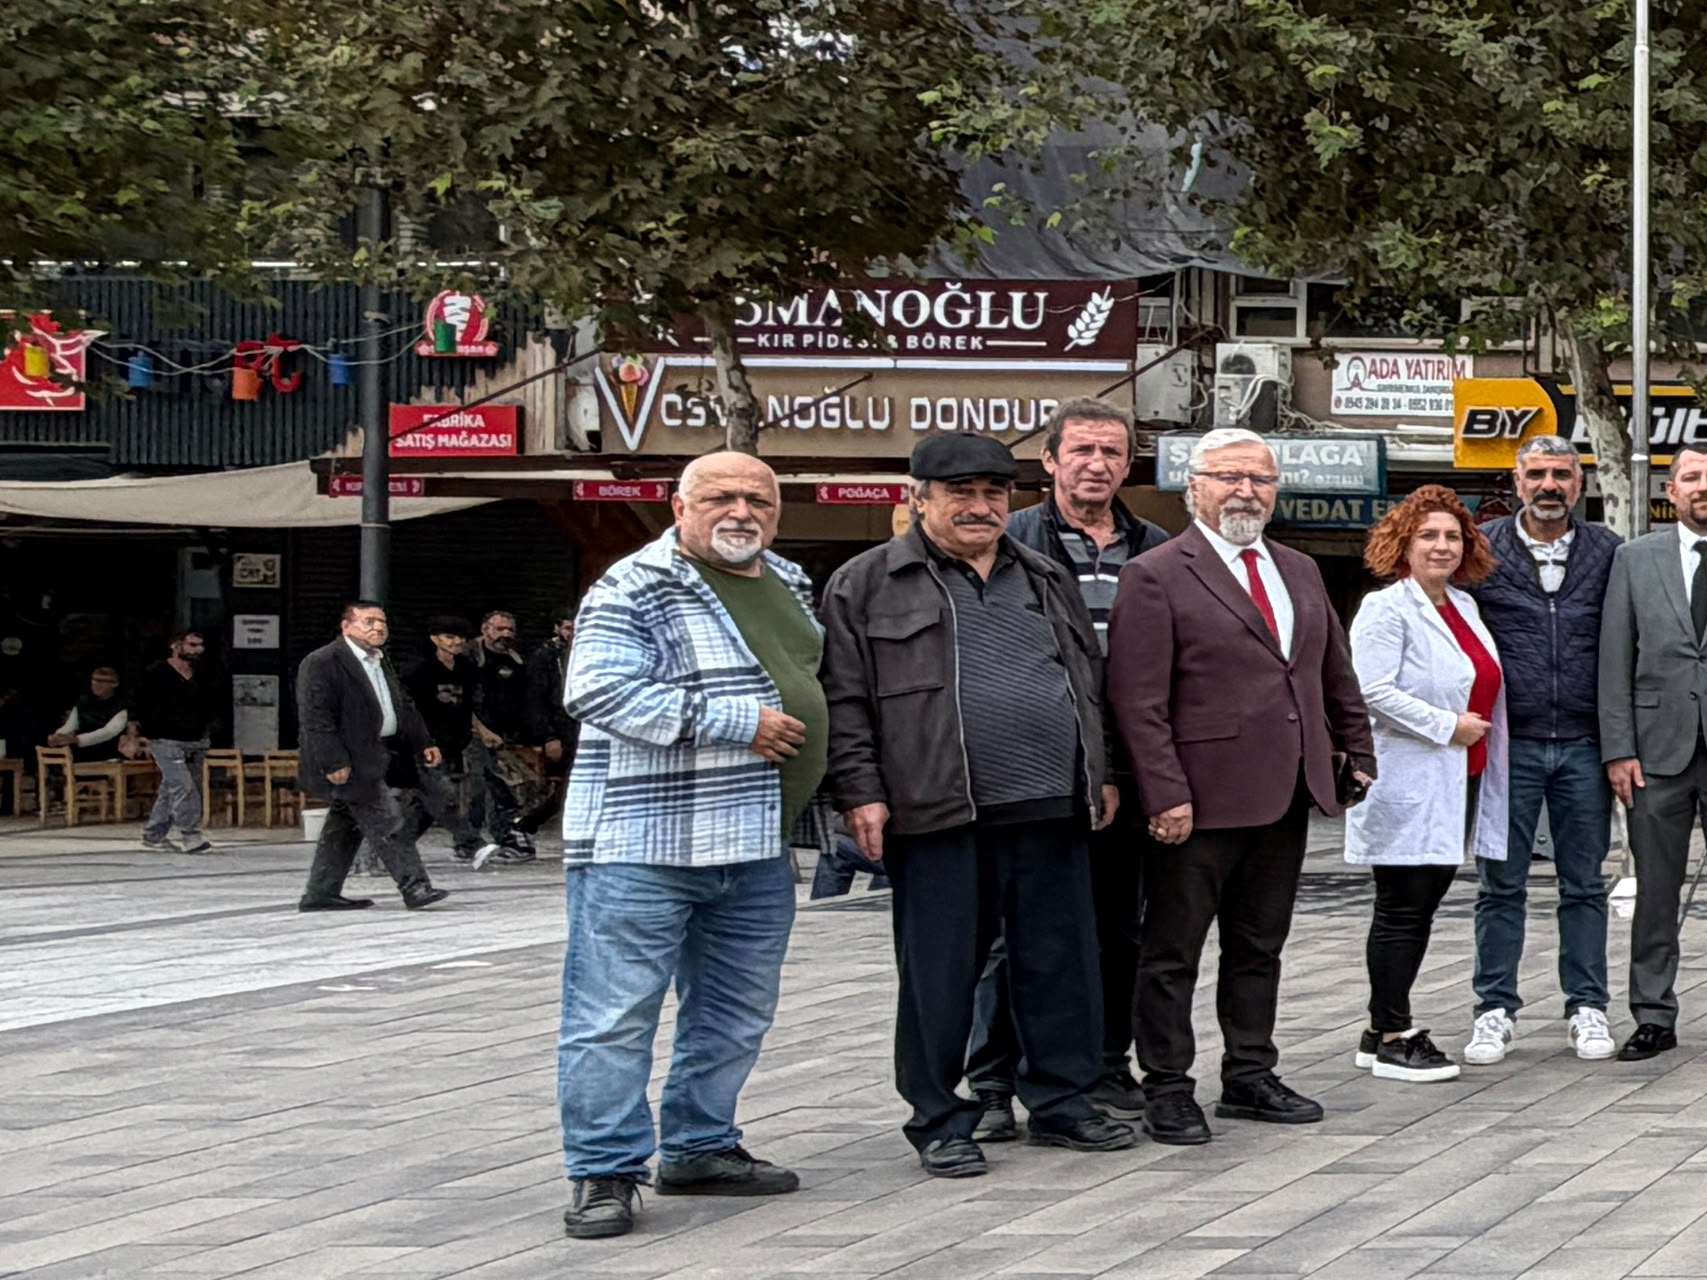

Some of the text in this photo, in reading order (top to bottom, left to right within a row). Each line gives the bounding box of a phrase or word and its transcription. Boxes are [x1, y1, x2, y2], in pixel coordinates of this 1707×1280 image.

[734, 282, 1048, 330] SMANOĞLU
[757, 332, 796, 348] KIR
[906, 331, 984, 351] BÖREK
[1367, 358, 1467, 380] ADA YATIRIM
[1462, 406, 1544, 440] BY
[394, 431, 513, 451] SATIŞ MAĞAZASI
[838, 486, 891, 500] POĞAÇA
[1280, 499, 1364, 521] VEDAT
